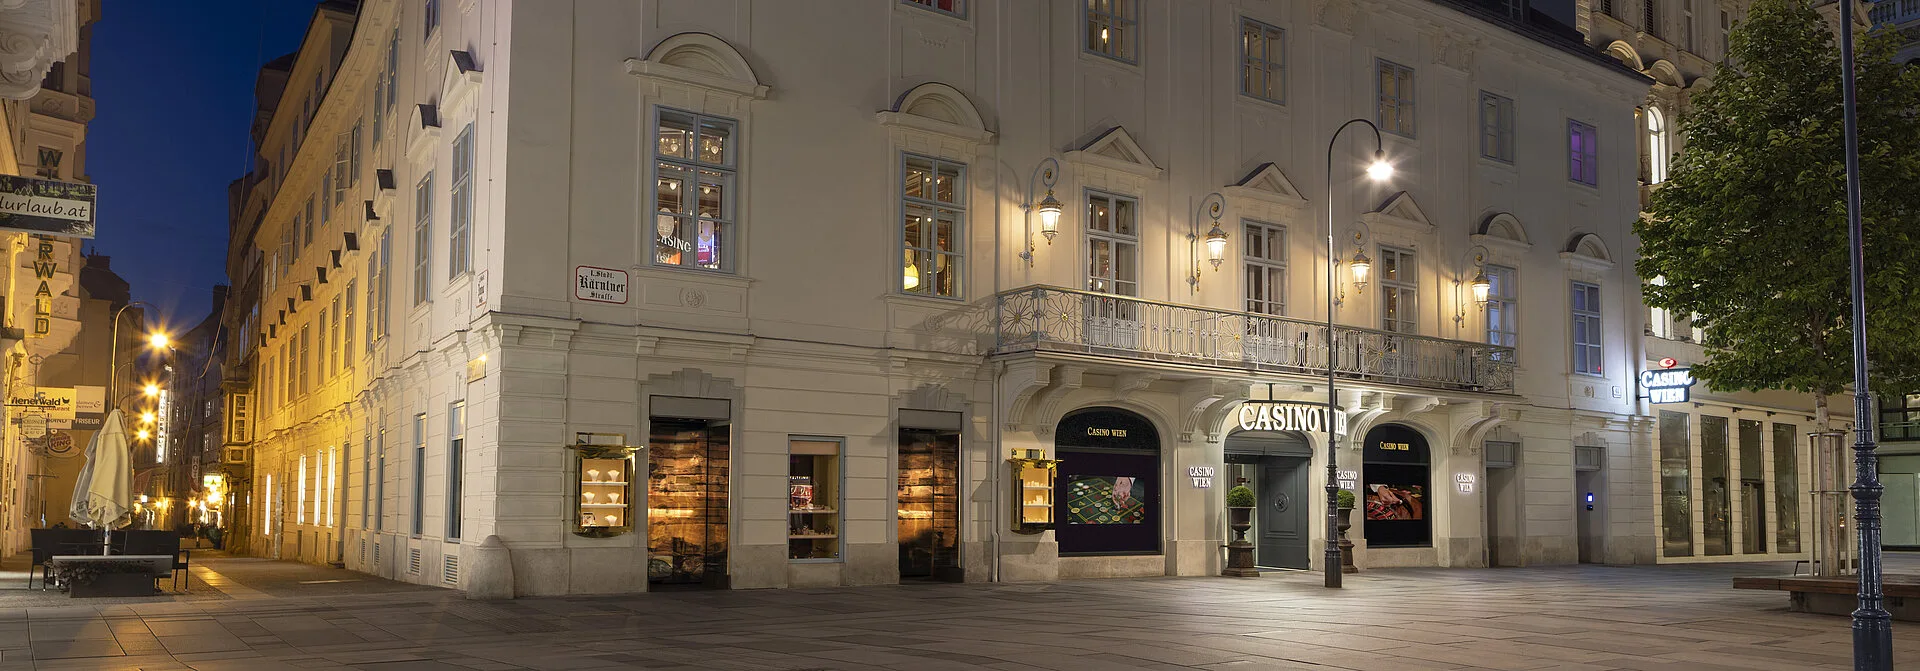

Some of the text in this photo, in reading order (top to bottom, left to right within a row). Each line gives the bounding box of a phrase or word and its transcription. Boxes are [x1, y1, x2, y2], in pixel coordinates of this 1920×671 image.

[579, 274, 626, 293] Kärntner
[1641, 370, 1693, 388] CASINO
[1649, 387, 1685, 403] WIEN
[1238, 405, 1319, 432] CASINO
[50, 439, 72, 449] KING
[1189, 466, 1214, 477] CASINO
[1336, 470, 1358, 480] CASINO
[1192, 477, 1211, 488] WIEN
[1456, 473, 1475, 483] CASINO
[1338, 480, 1355, 490] WIEN
[1459, 483, 1473, 492] WIEN
